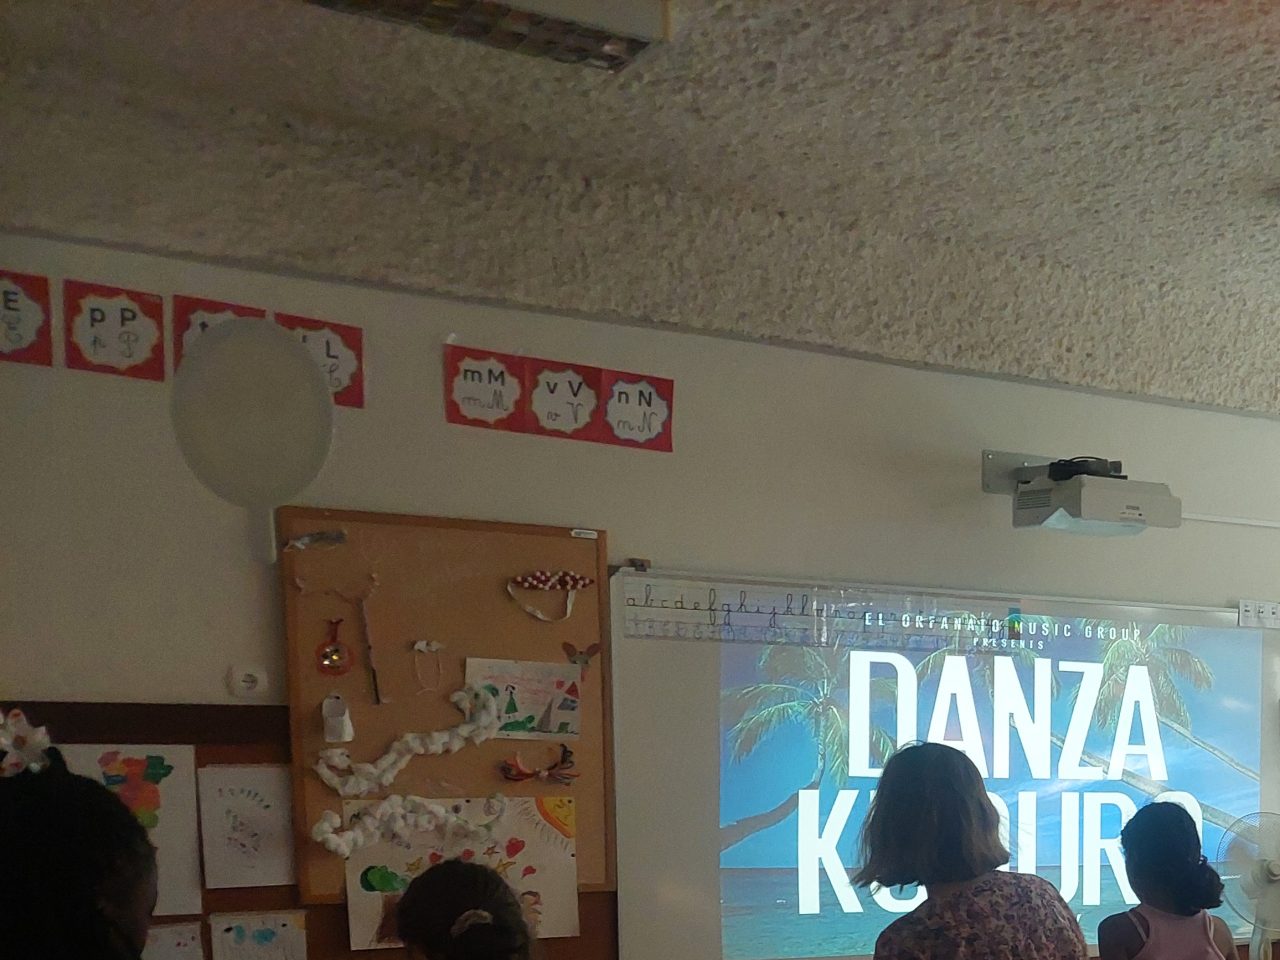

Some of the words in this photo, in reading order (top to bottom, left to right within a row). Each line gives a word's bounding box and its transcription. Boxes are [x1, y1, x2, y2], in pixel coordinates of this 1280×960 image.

[325, 339, 339, 359] L
[638, 389, 652, 408] N
[865, 612, 886, 626] EL
[901, 613, 1000, 633] ORFANATO
[1014, 621, 1071, 637] MUSIC
[1084, 625, 1140, 641] GROUP
[973, 637, 1044, 650] PRESENTS
[848, 650, 1168, 781] DANZA
